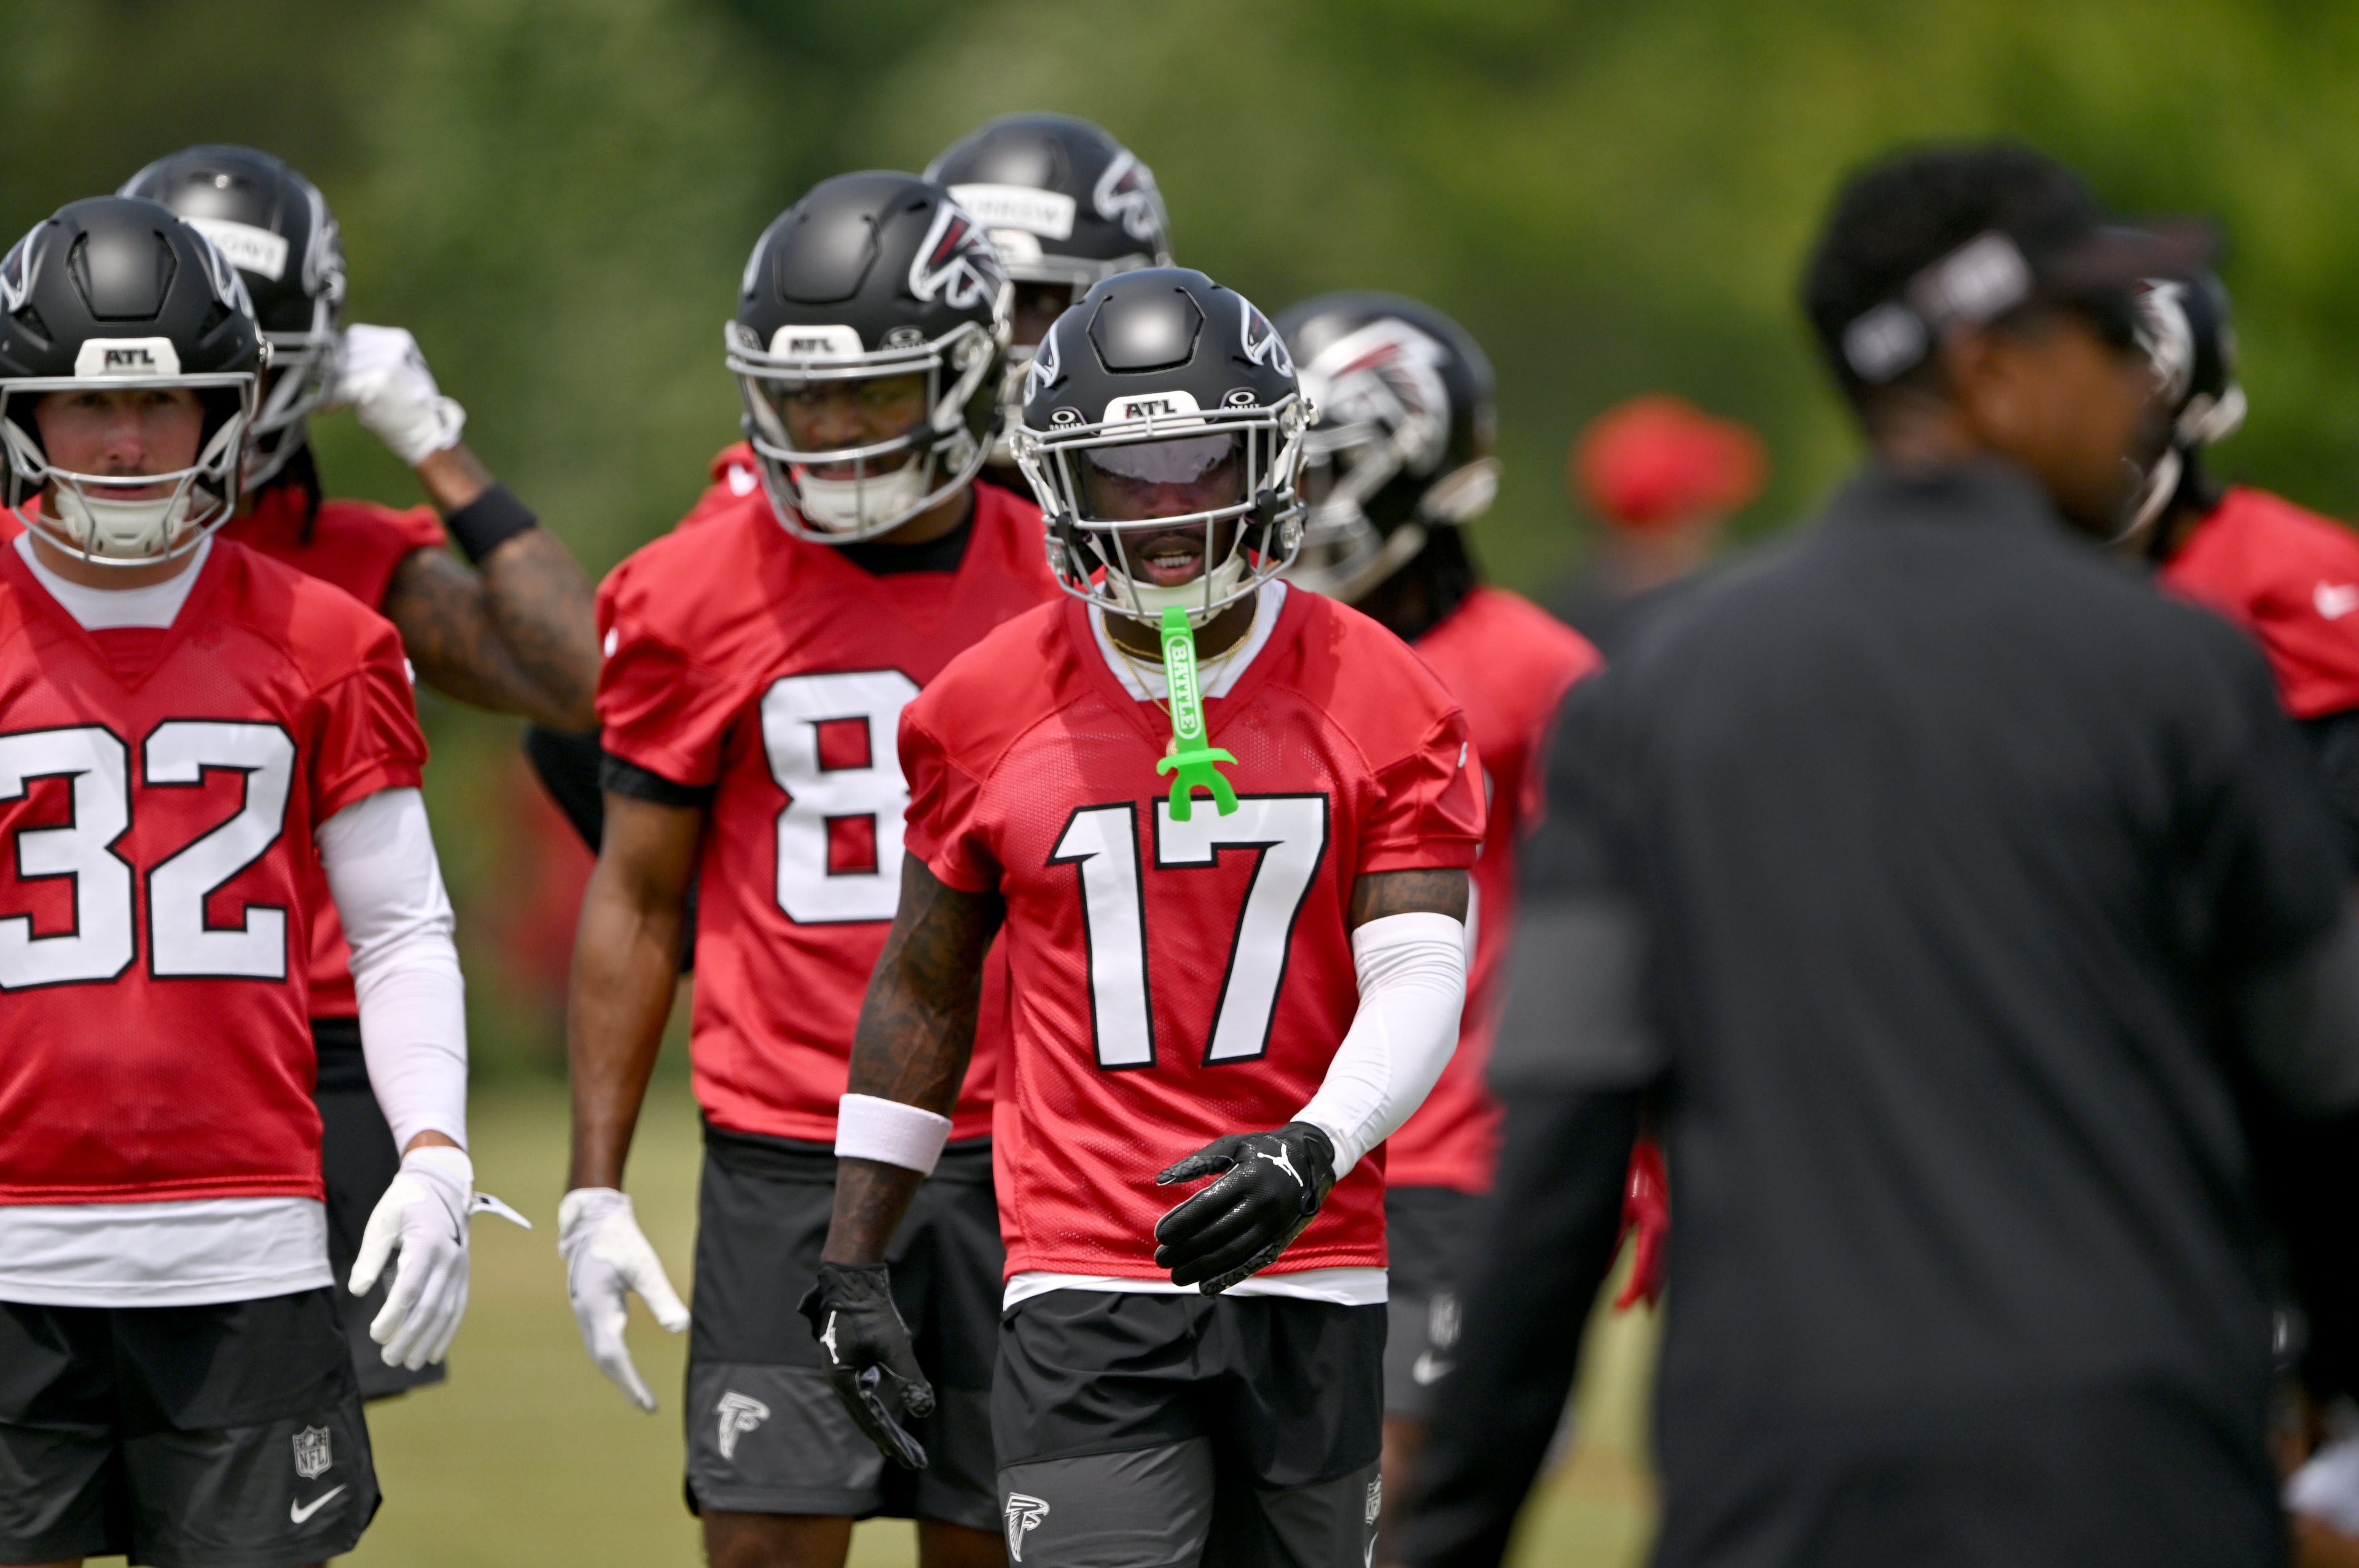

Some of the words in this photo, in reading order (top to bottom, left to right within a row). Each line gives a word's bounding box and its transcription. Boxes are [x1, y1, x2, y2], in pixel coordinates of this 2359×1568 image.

[104, 348, 155, 366] ATL
[1123, 399, 1178, 419] ATL
[1171, 645, 1195, 730] BATTLE
[0, 717, 297, 993] 32
[1045, 792, 1329, 1070] 17
[299, 1446, 326, 1471] NFL
